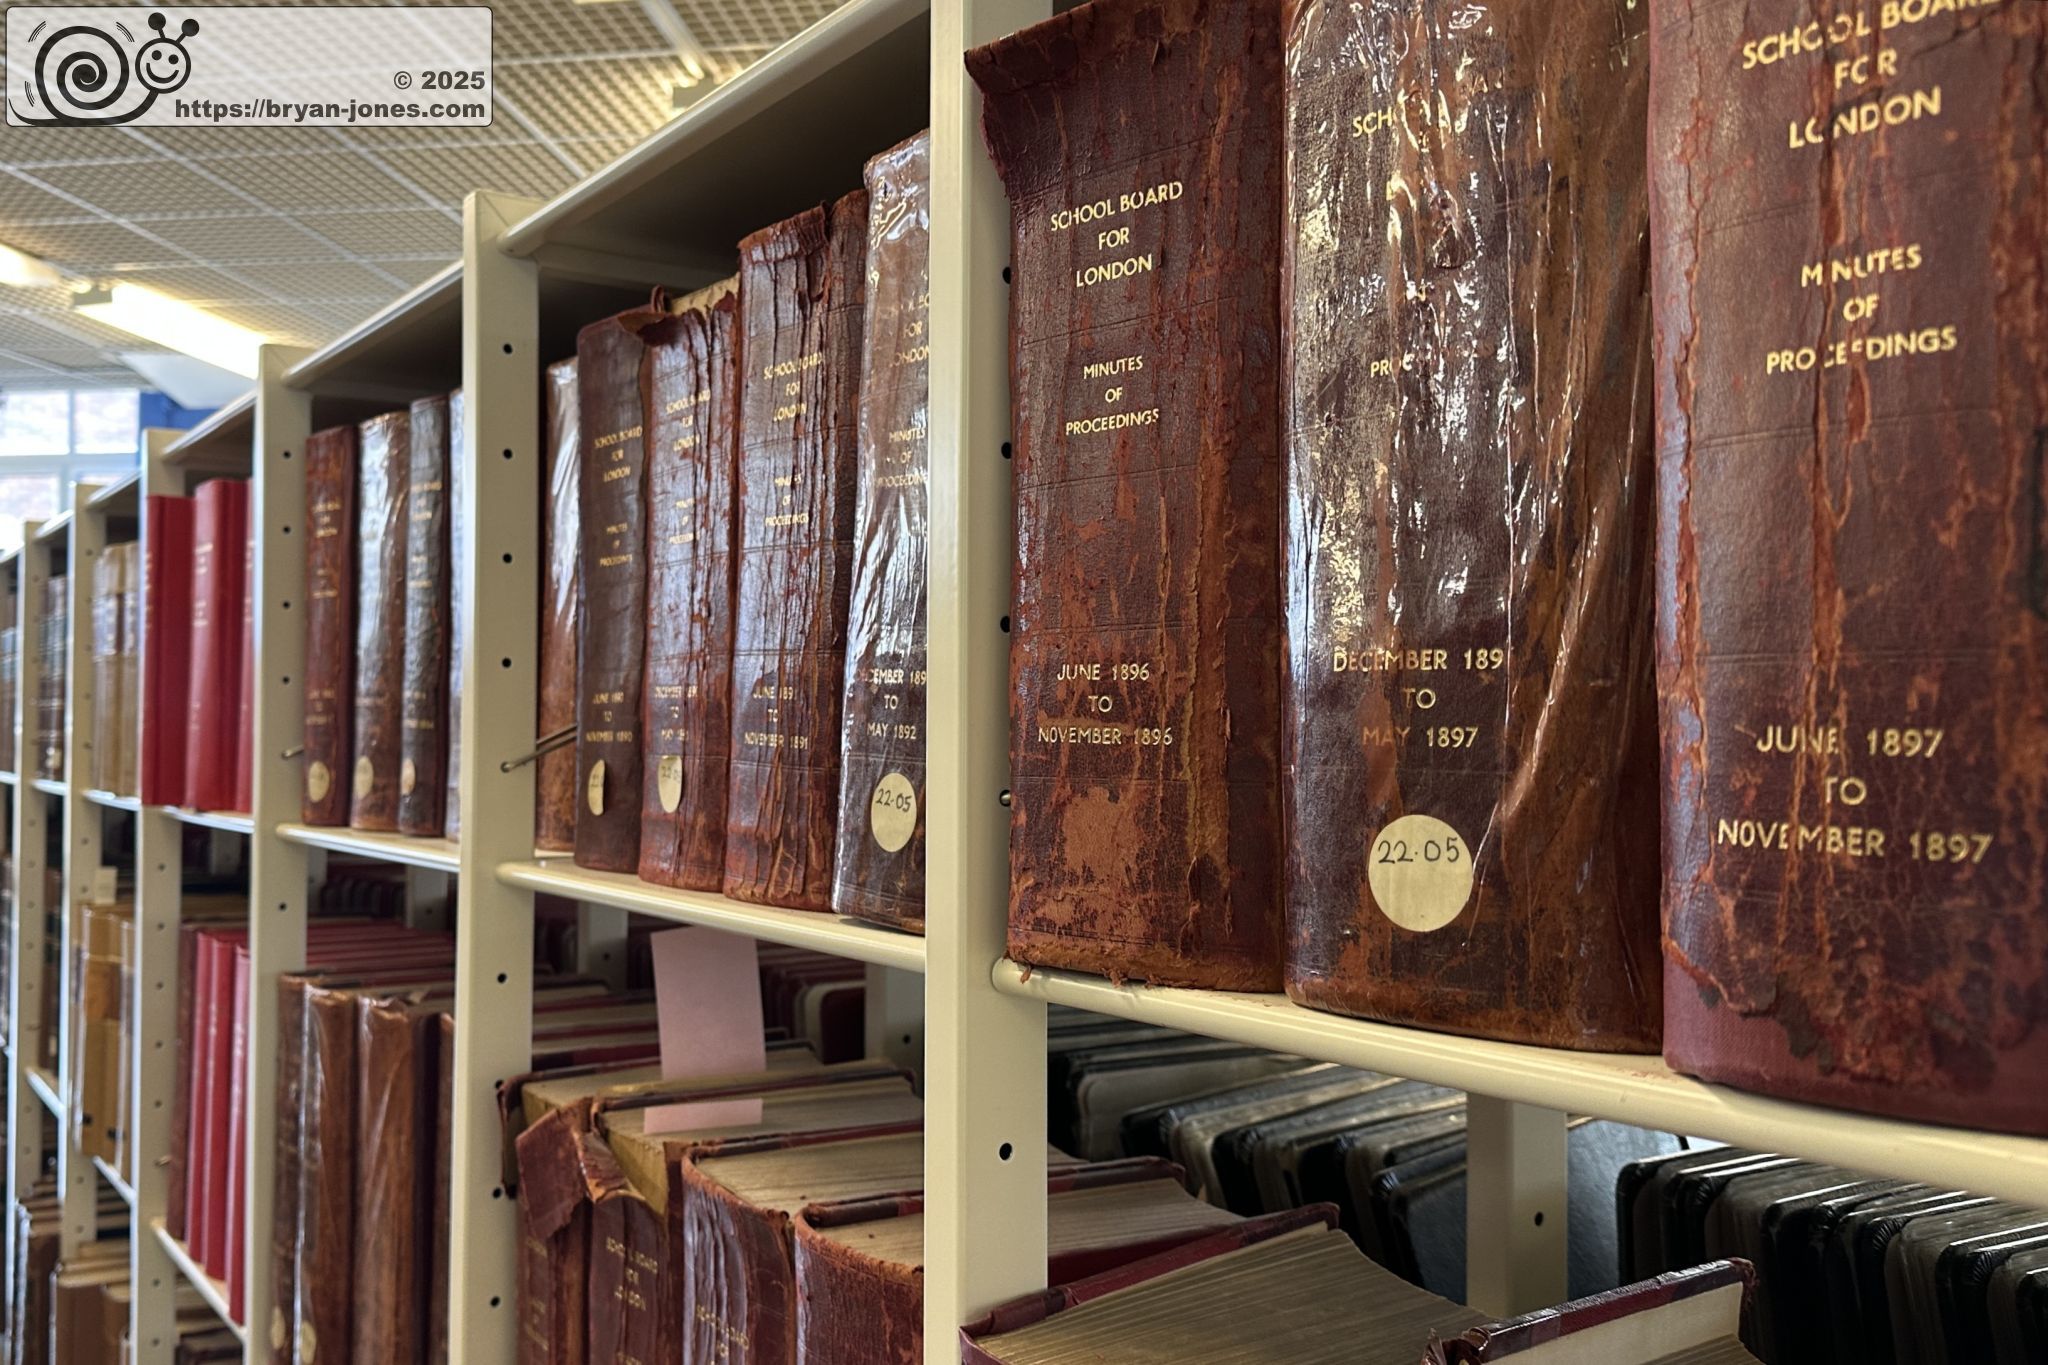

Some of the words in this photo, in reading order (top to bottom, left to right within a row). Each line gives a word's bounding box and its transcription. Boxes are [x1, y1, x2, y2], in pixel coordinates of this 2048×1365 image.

[1742, 11, 1871, 70] SCHOOL
[1834, 48, 1897, 89] FOR
[1789, 85, 1941, 149] LONDON
[1050, 198, 1115, 232] SCHOOL
[1120, 181, 1183, 213] BOARD
[1098, 227, 1130, 250] FOR
[1076, 254, 1152, 288] LONDON
[1801, 243, 1922, 288] MNUTES
[1842, 293, 1879, 322] OF
[1083, 355, 1143, 380] MINUTES
[1105, 387, 1123, 403] OF
[1066, 408, 1159, 436] PROCEEDINGS
[1057, 664, 1100, 681] JUNE
[1112, 663, 1150, 681] 1896
[1333, 648, 1448, 672] DECEMBER
[910, 670, 927, 685] 189
[884, 694, 898, 710] TO
[1088, 695, 1113, 712] TO
[1403, 687, 1436, 709] TO
[867, 721, 889, 737] MAY
[894, 724, 917, 740] 1892
[1038, 727, 1122, 745] NOVEMBER
[1134, 728, 1173, 746] 1896
[1362, 726, 1411, 747] MAY
[1426, 726, 1479, 748] 1897
[1756, 725, 1839, 754] JUNE
[1867, 728, 1945, 758] 1897
[1824, 776, 1867, 806] TO
[1717, 818, 1885, 857] NOVEMBER
[1909, 831, 1993, 864] 1897
